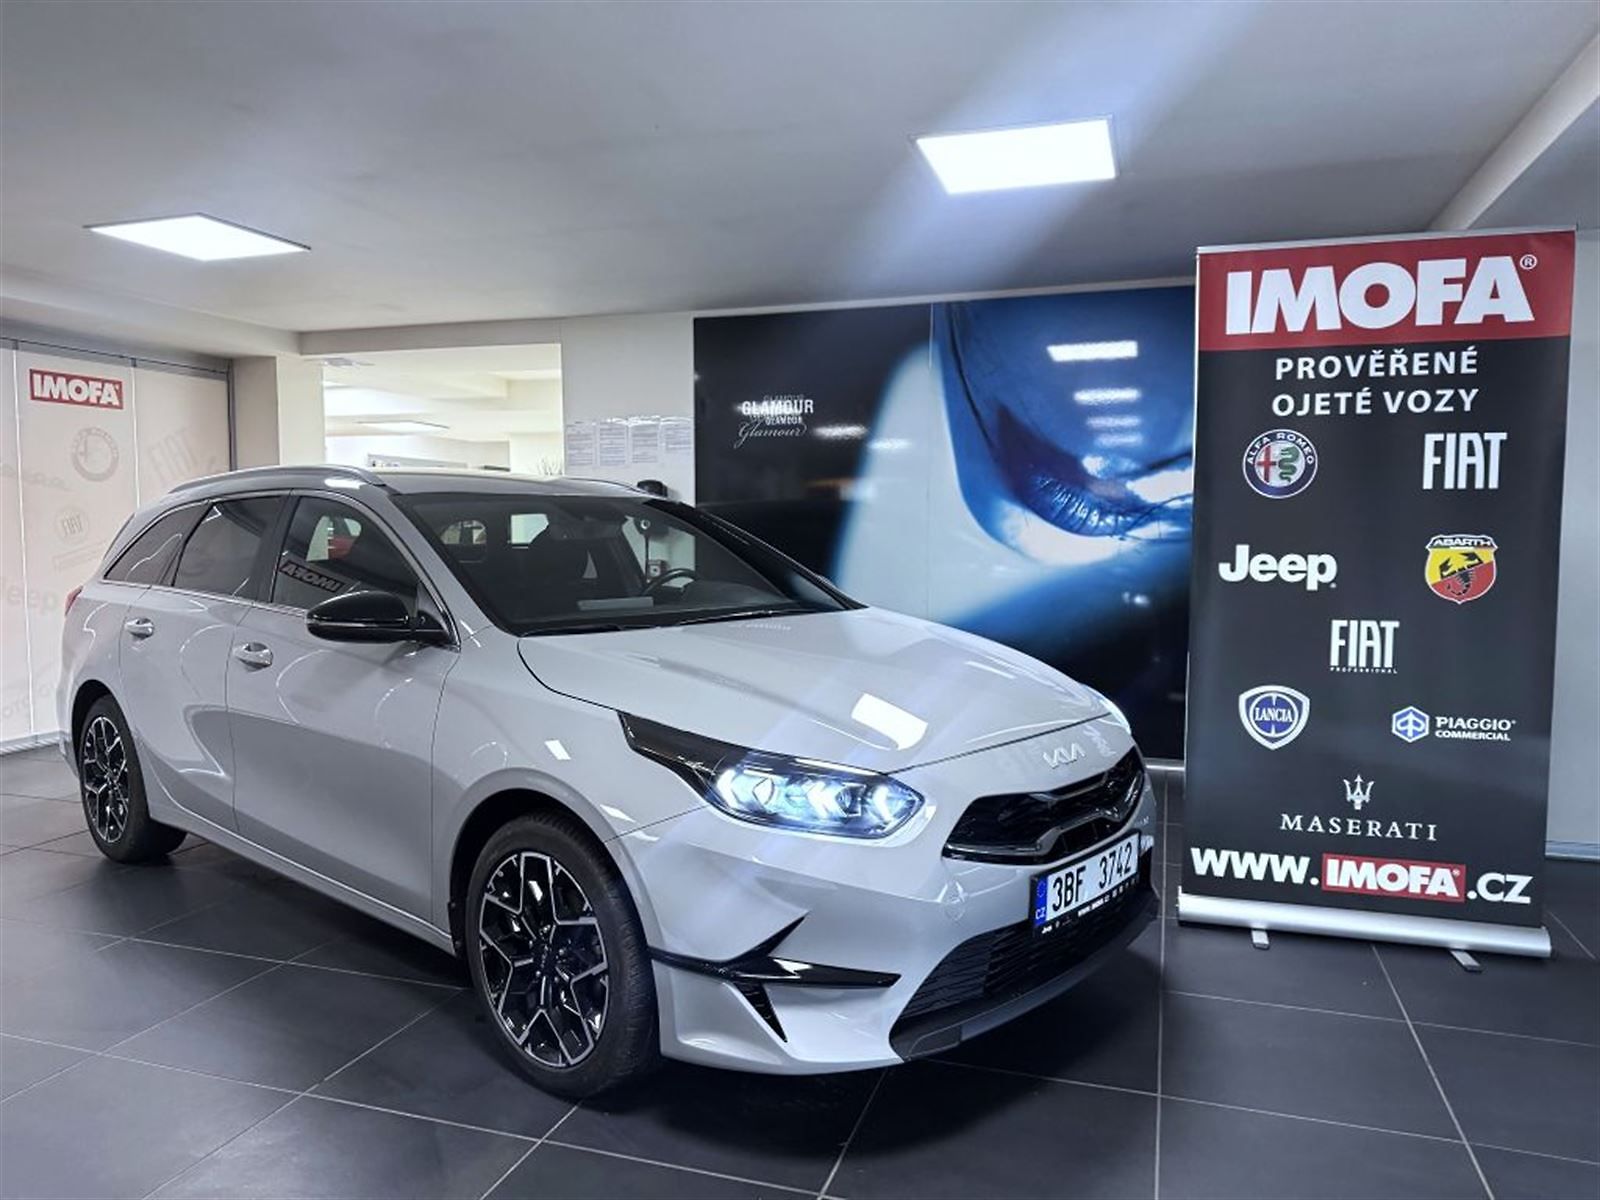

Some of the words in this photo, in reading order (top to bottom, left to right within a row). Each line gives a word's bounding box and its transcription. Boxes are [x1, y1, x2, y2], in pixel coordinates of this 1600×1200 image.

[1225, 255, 1535, 335] IMOFA
[1275, 346, 1478, 380] PROVĚŘENÉ
[32, 374, 120, 406] IMOFA
[1272, 387, 1372, 416] OJETÉ
[1383, 388, 1479, 414] VOZY
[741, 399, 813, 416] GLAMOUR
[1247, 436, 1270, 464] ALFA
[1276, 432, 1315, 465] ROMEO
[1422, 432, 1507, 490] FIAT
[1432, 538, 1491, 547] ABARTH
[1218, 544, 1338, 591] Jeep
[1330, 619, 1400, 668] FIAT
[1254, 706, 1293, 723] LANCIA
[1435, 716, 1512, 731] PIAGGIO
[1435, 730, 1512, 741] COMMERCIAL
[1279, 813, 1437, 842] MASERATI
[1052, 866, 1086, 912] 3BF
[1098, 842, 1133, 889] 3742
[1035, 906, 1046, 920] CZ
